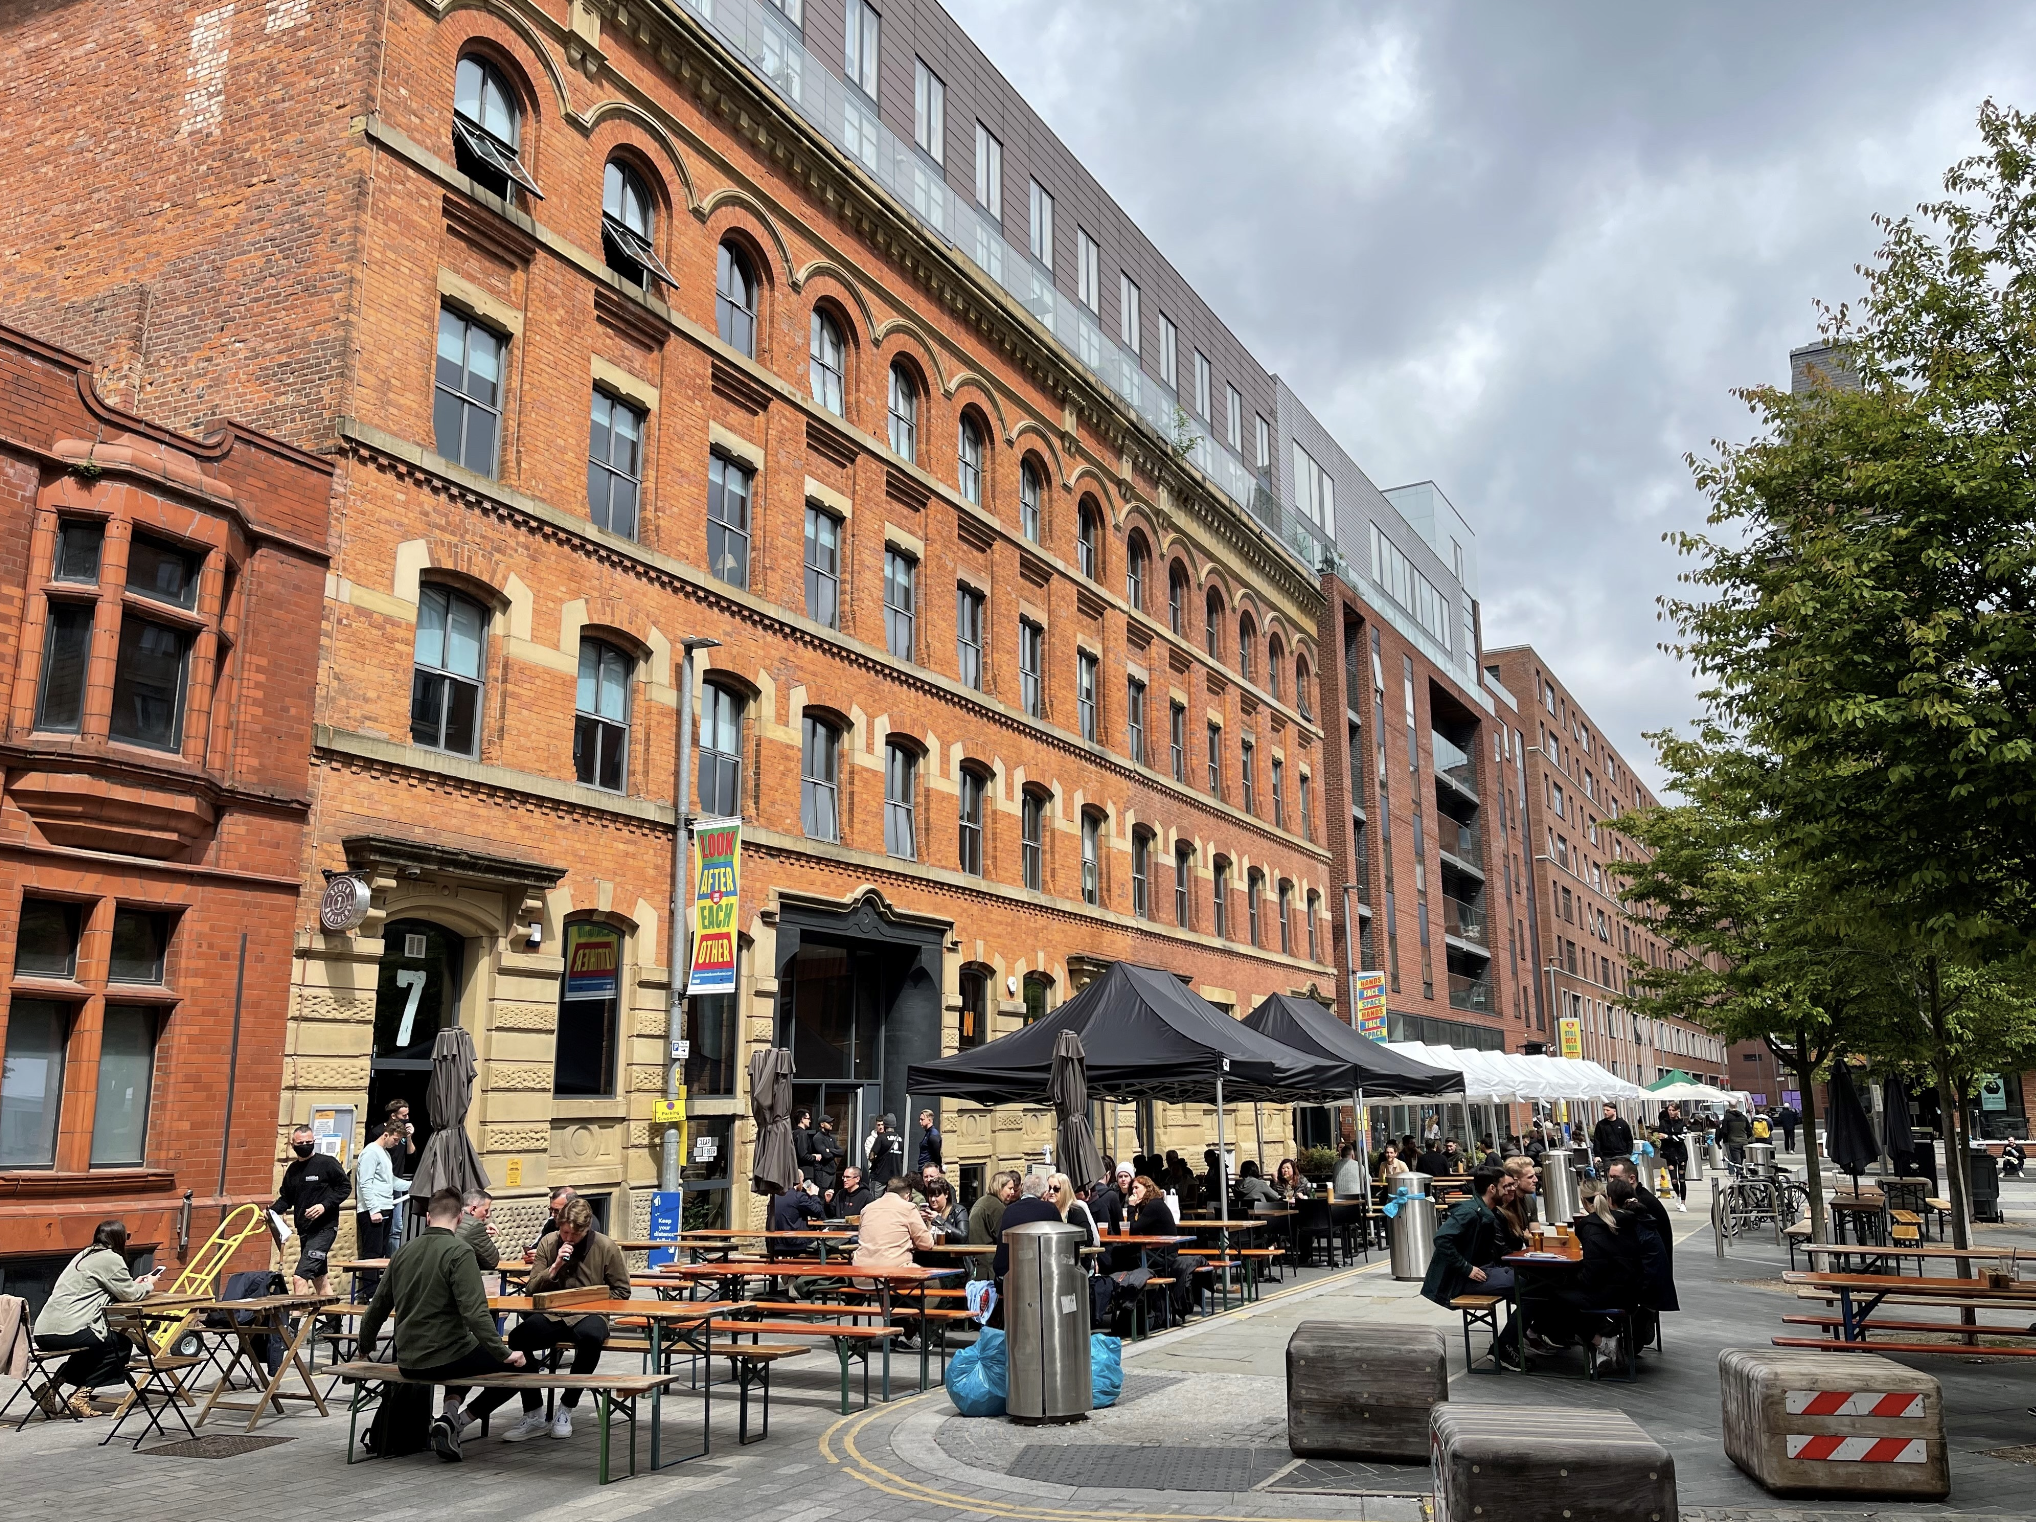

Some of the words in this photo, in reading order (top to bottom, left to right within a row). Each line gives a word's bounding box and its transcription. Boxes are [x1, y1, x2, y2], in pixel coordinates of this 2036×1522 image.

[700, 831, 736, 859] LOOK
[700, 867, 734, 894] AFTER
[330, 883, 351, 896] SEVEN
[337, 896, 342, 909] 7
[325, 905, 352, 923] BROTHERS
[700, 903, 734, 929] EACH
[698, 939, 731, 964] OTHER
[1360, 976, 1382, 987] HANDS
[1363, 988, 1379, 998] FACE
[396, 969, 427, 1047] 7
[1362, 998, 1382, 1008] SPACE
[1361, 1008, 1384, 1018] HANDS
[963, 1011, 974, 1036] N
[1365, 1020, 1380, 1029] FACE
